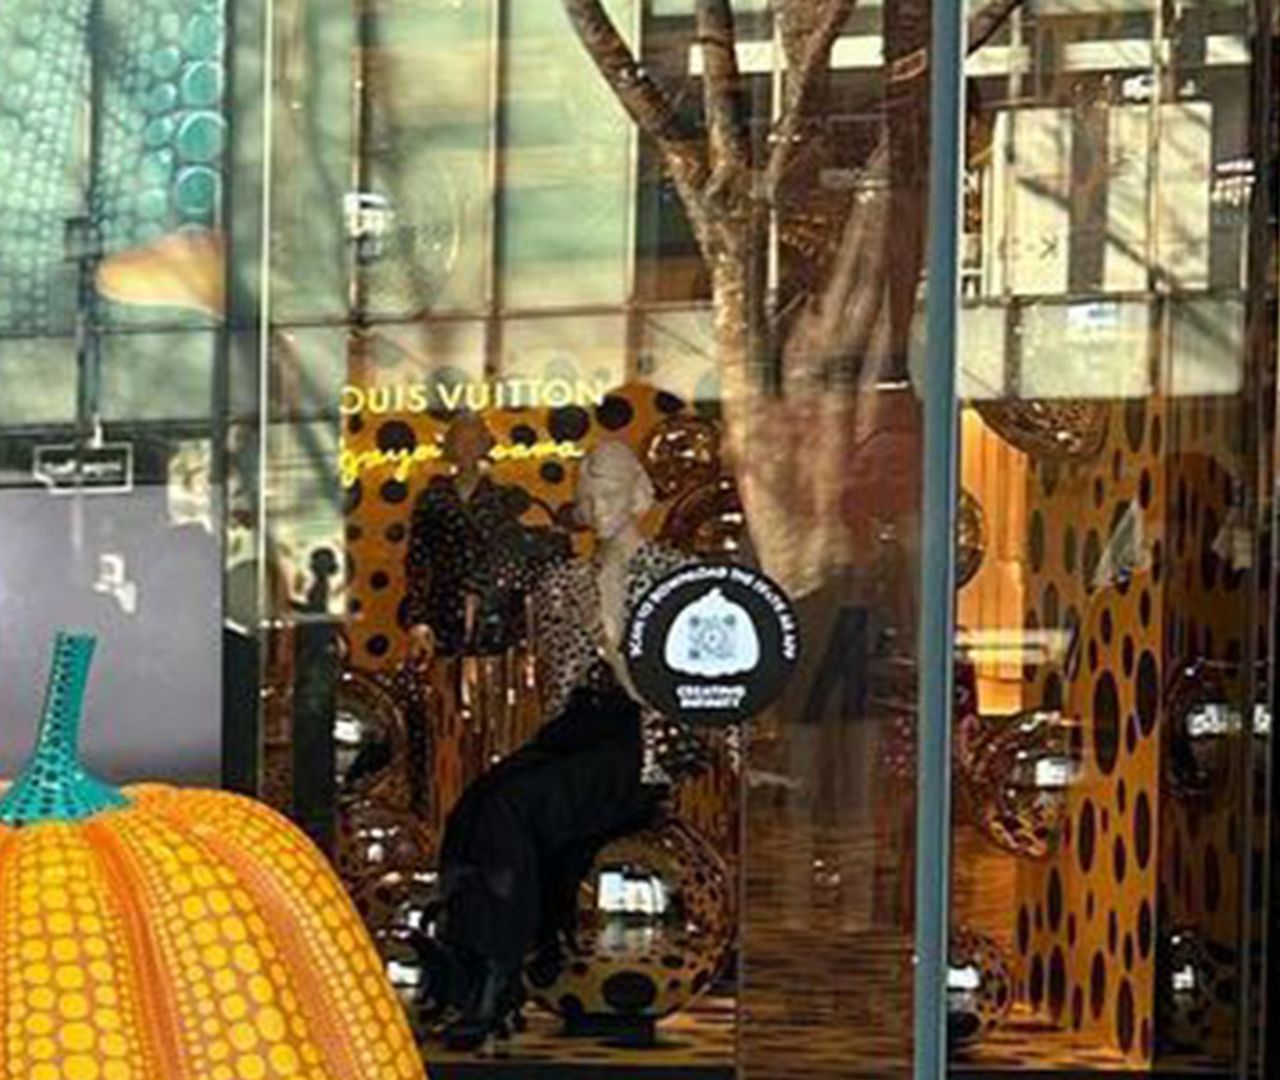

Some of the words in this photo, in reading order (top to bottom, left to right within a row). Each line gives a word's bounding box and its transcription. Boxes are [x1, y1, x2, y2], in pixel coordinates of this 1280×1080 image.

[340, 383, 428, 415] OUIS
[438, 378, 606, 412] VUITTON
[628, 620, 646, 659] SCAN
[637, 603, 655, 619] TO
[649, 566, 728, 603] DOWNLOAD
[730, 568, 755, 587] THE
[782, 634, 797, 660] APP
